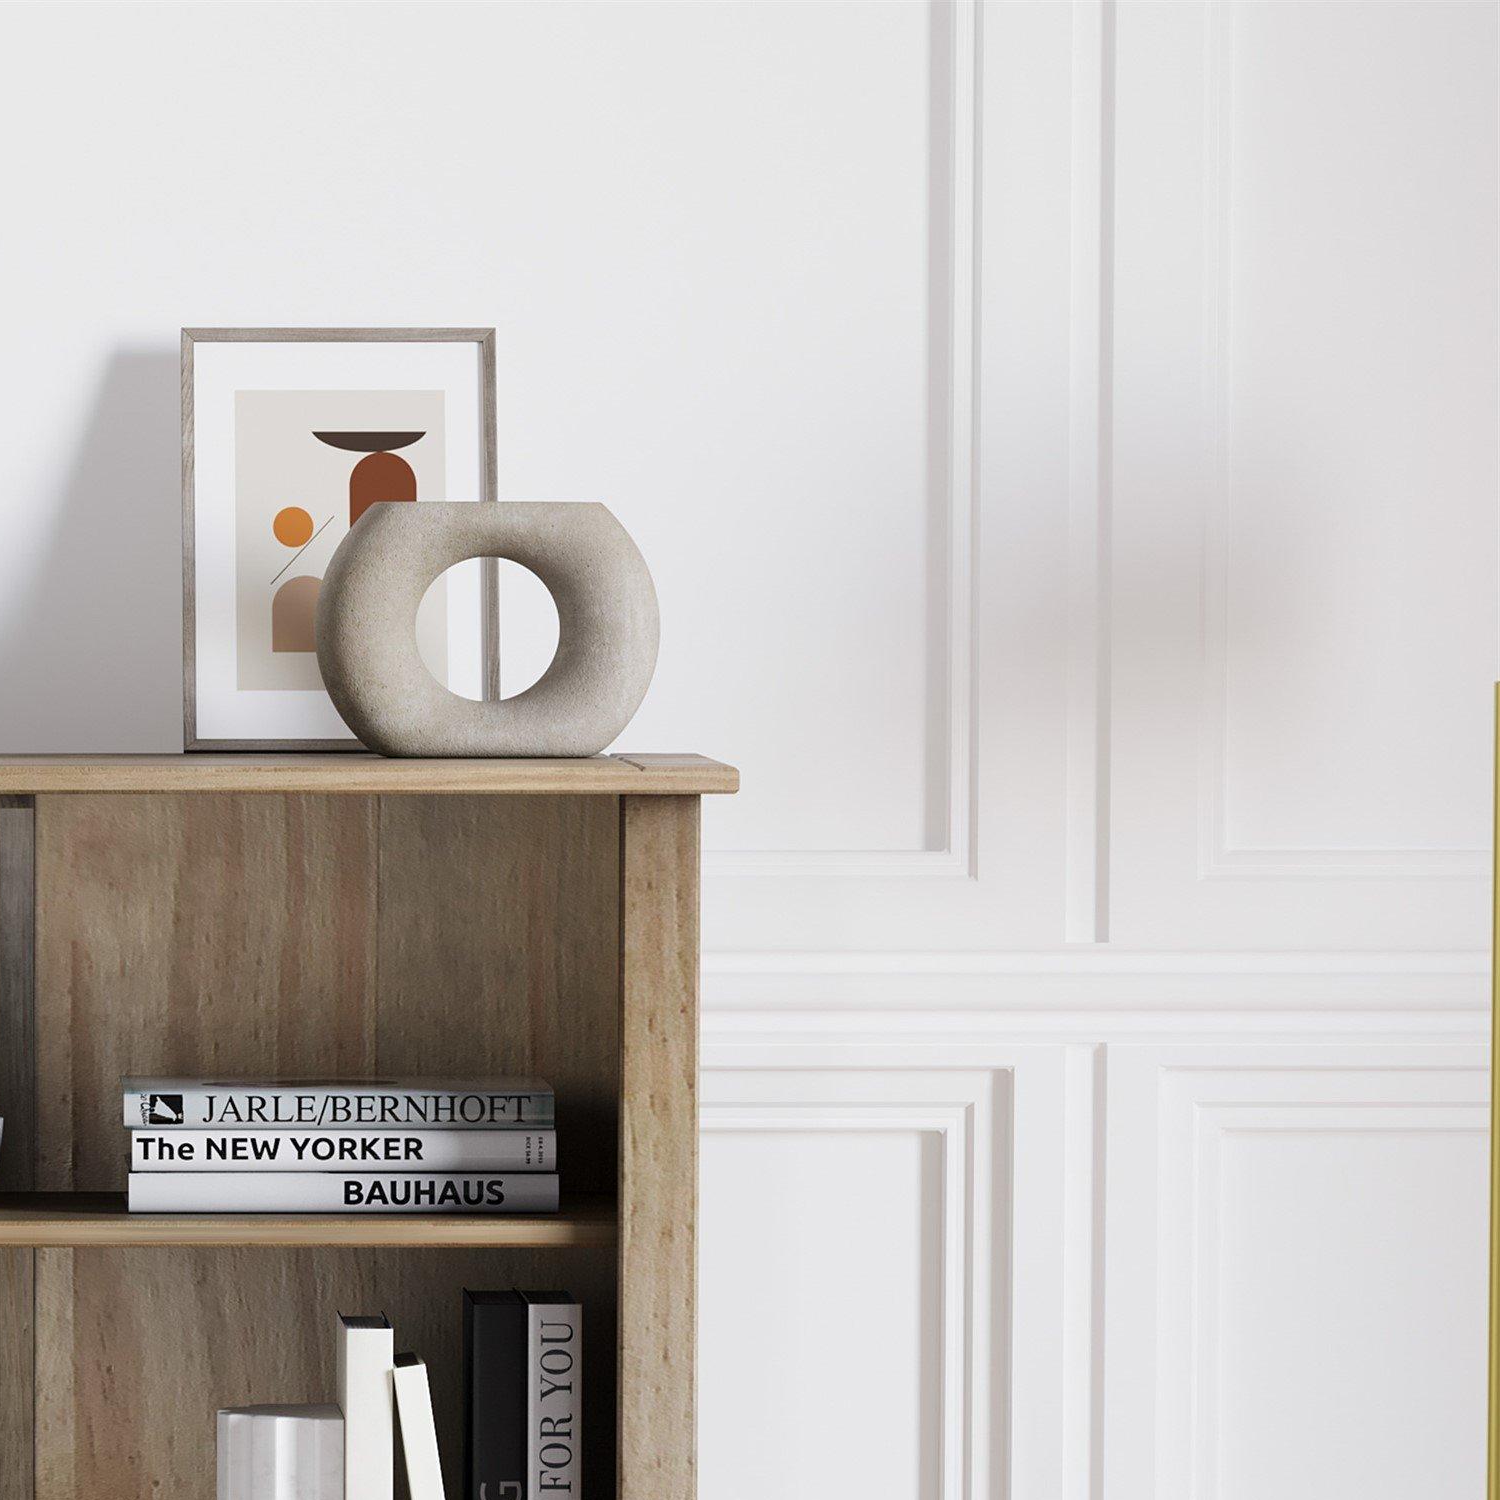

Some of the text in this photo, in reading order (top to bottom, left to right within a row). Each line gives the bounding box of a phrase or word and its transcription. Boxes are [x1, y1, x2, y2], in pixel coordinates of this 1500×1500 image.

[202, 1094, 532, 1124] JARLE/BERNHOFT
[136, 1137, 424, 1161] The NEW YORKER
[343, 1179, 506, 1206] BAUHAUS
[539, 1319, 575, 1402] YOU
[539, 1412, 574, 1494] FOR
